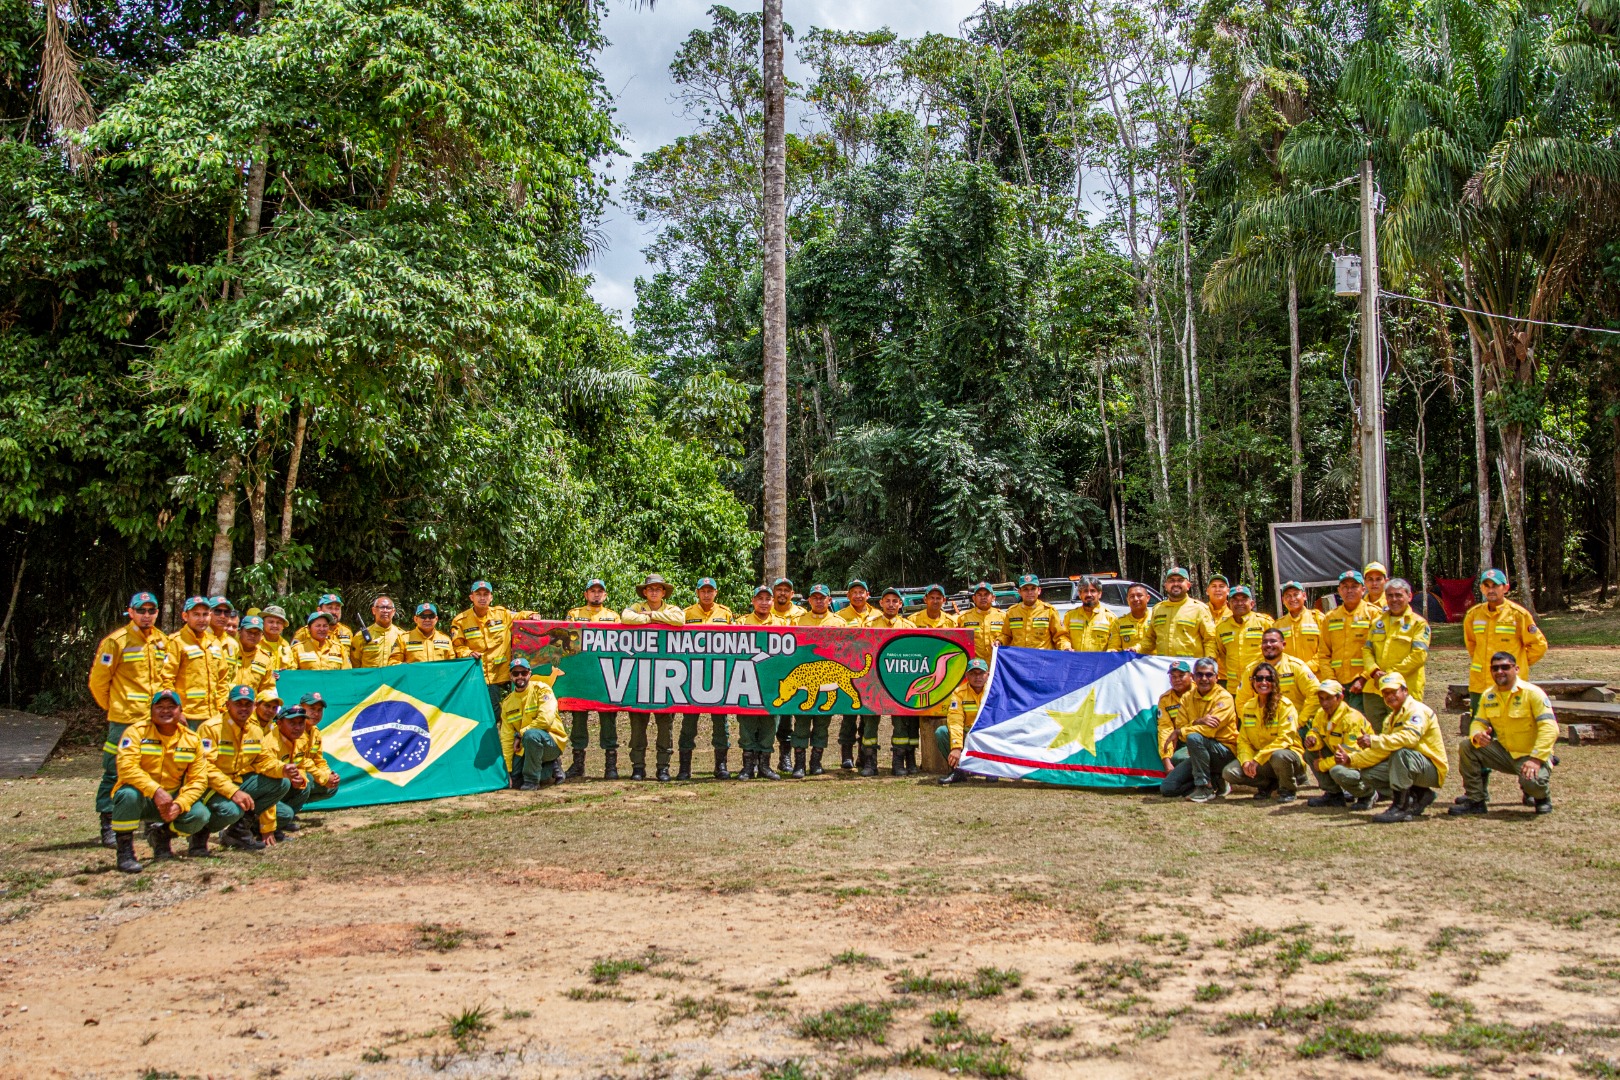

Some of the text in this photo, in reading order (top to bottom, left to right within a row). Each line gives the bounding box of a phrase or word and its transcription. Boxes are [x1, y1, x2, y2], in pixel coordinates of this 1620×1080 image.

[582, 630, 796, 656] PARQUE NACIONAL DO
[885, 656, 930, 673] VIRUÁ
[599, 651, 770, 705] VIRUÁ
